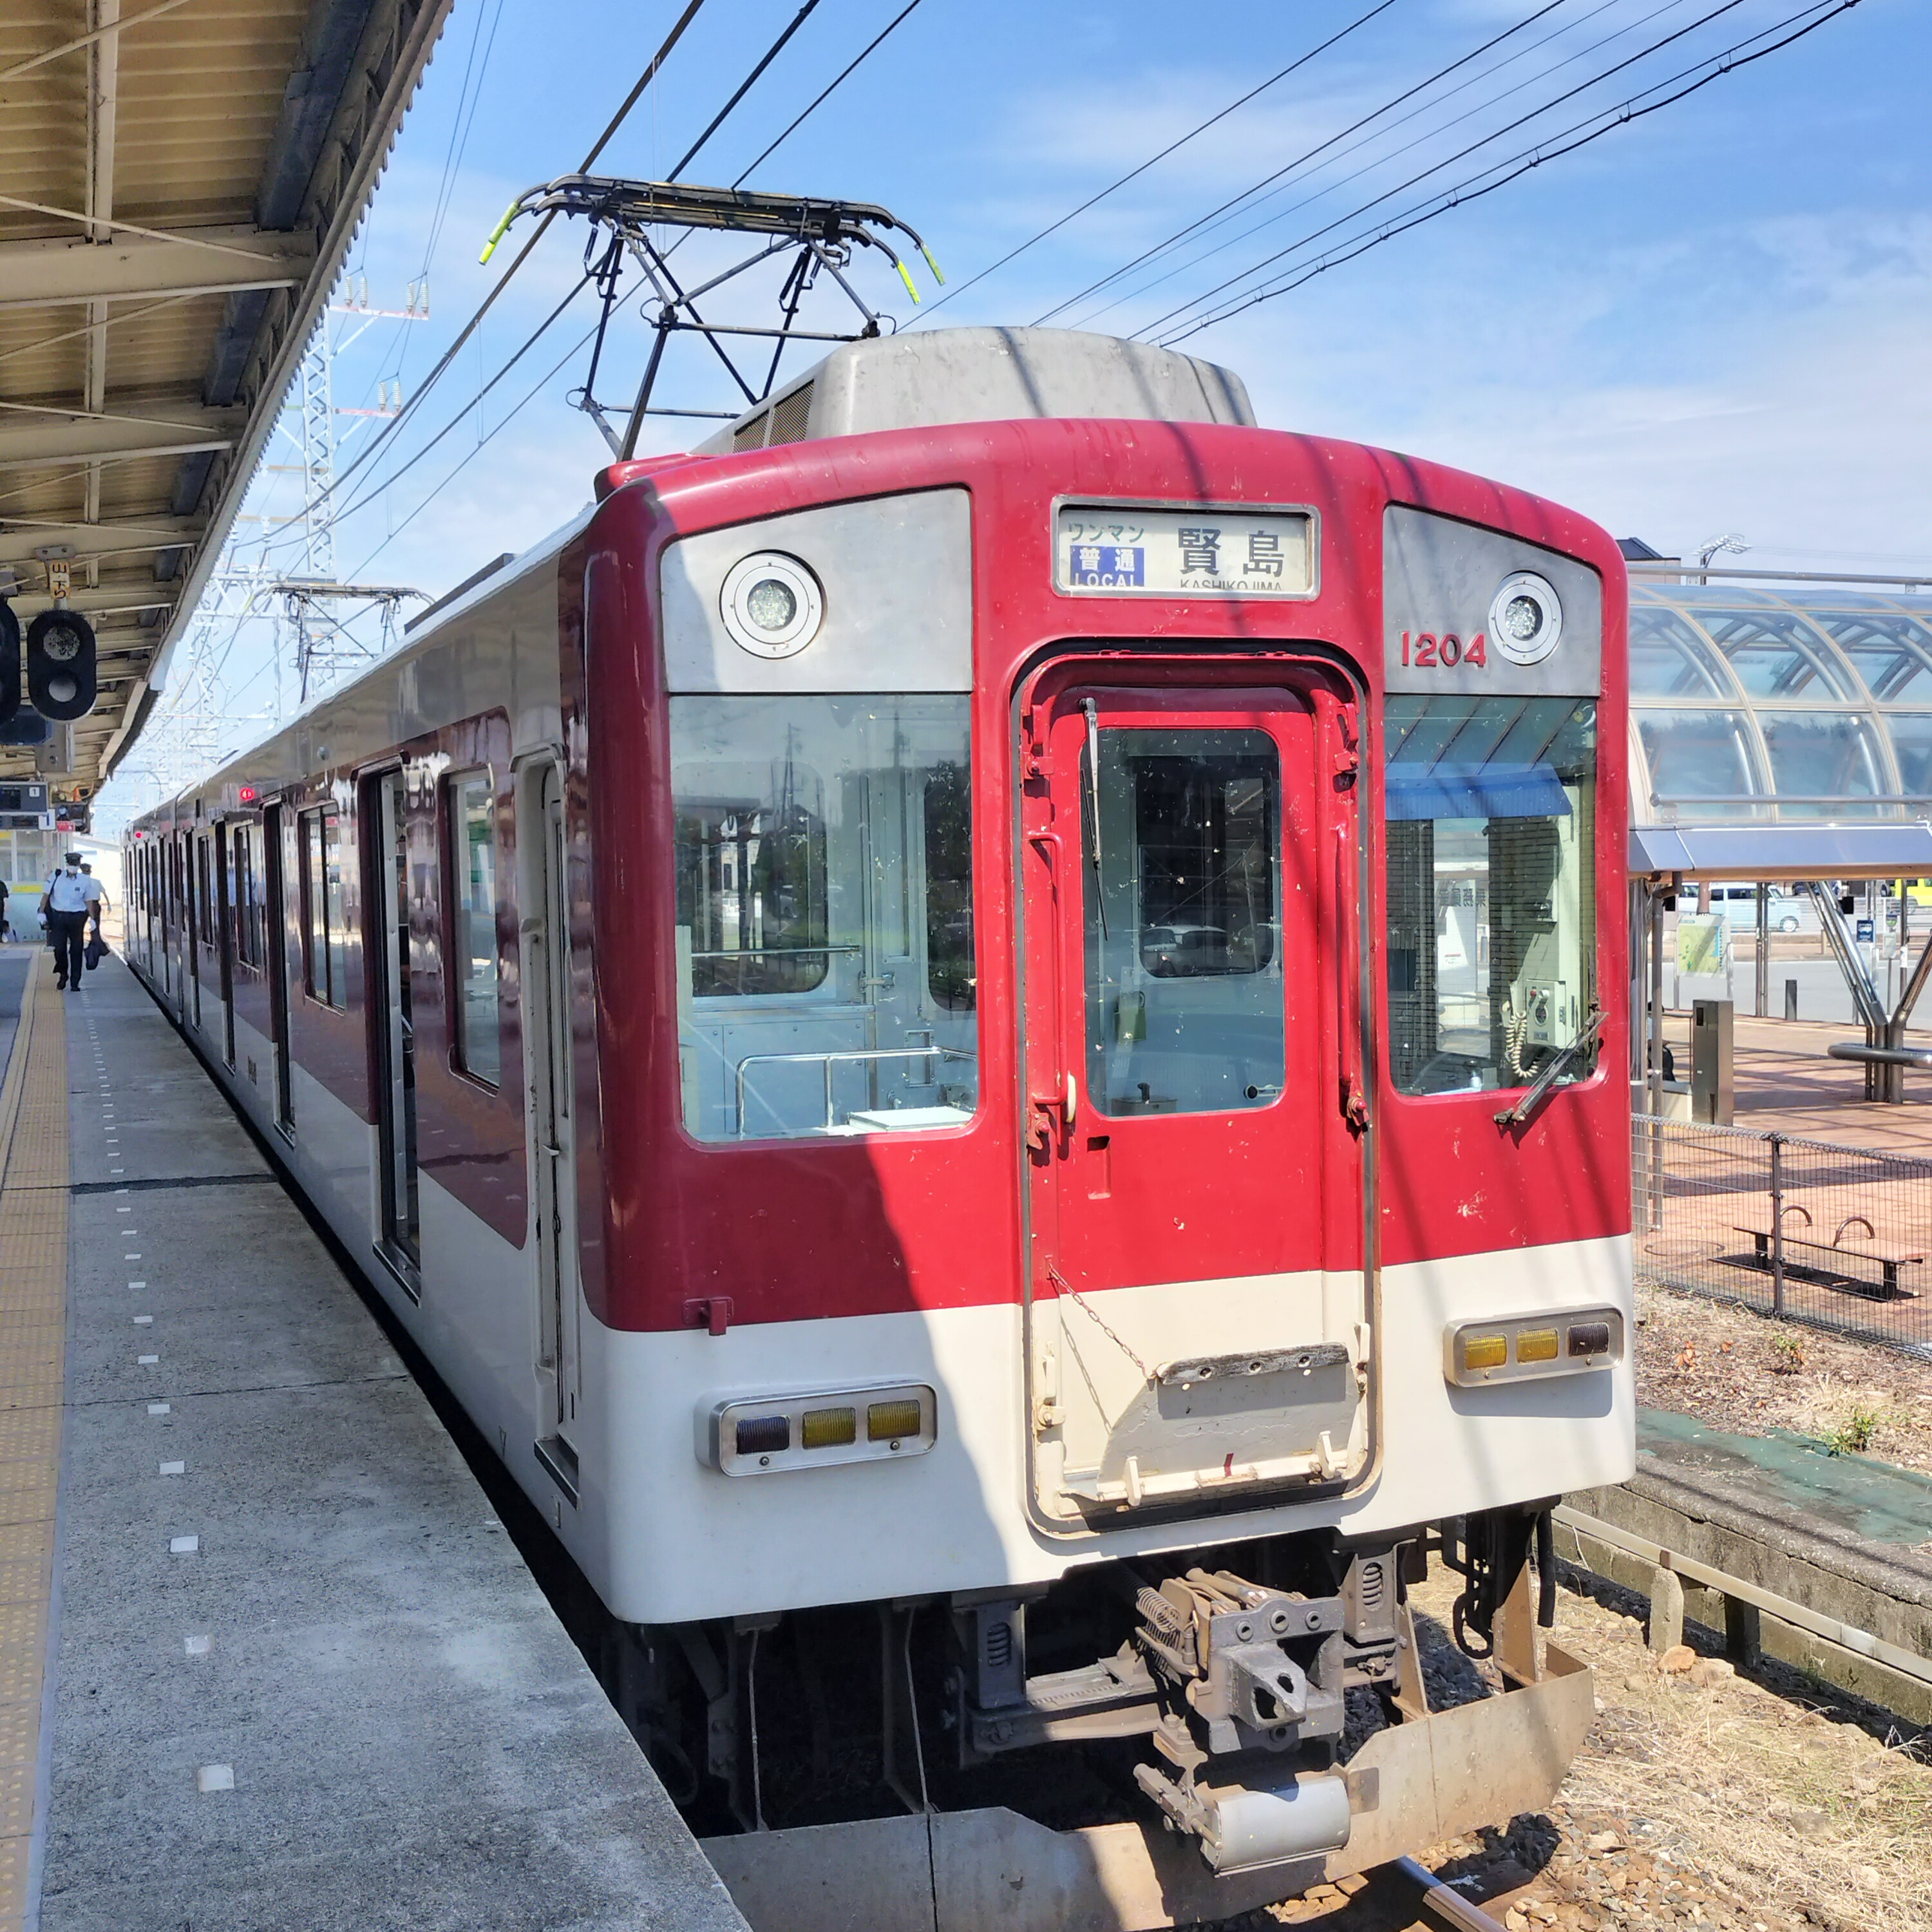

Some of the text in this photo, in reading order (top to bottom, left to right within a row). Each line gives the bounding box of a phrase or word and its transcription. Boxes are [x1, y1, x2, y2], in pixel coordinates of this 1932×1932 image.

[1068, 522, 1144, 543] ワンマン
[1079, 547, 1135, 572] 普通
[1178, 527, 1285, 578] 賢島
[1074, 573, 1139, 587] LOCAL
[1180, 579, 1282, 591] KASHIKOJIMA
[1401, 630, 1488, 667] 1204
